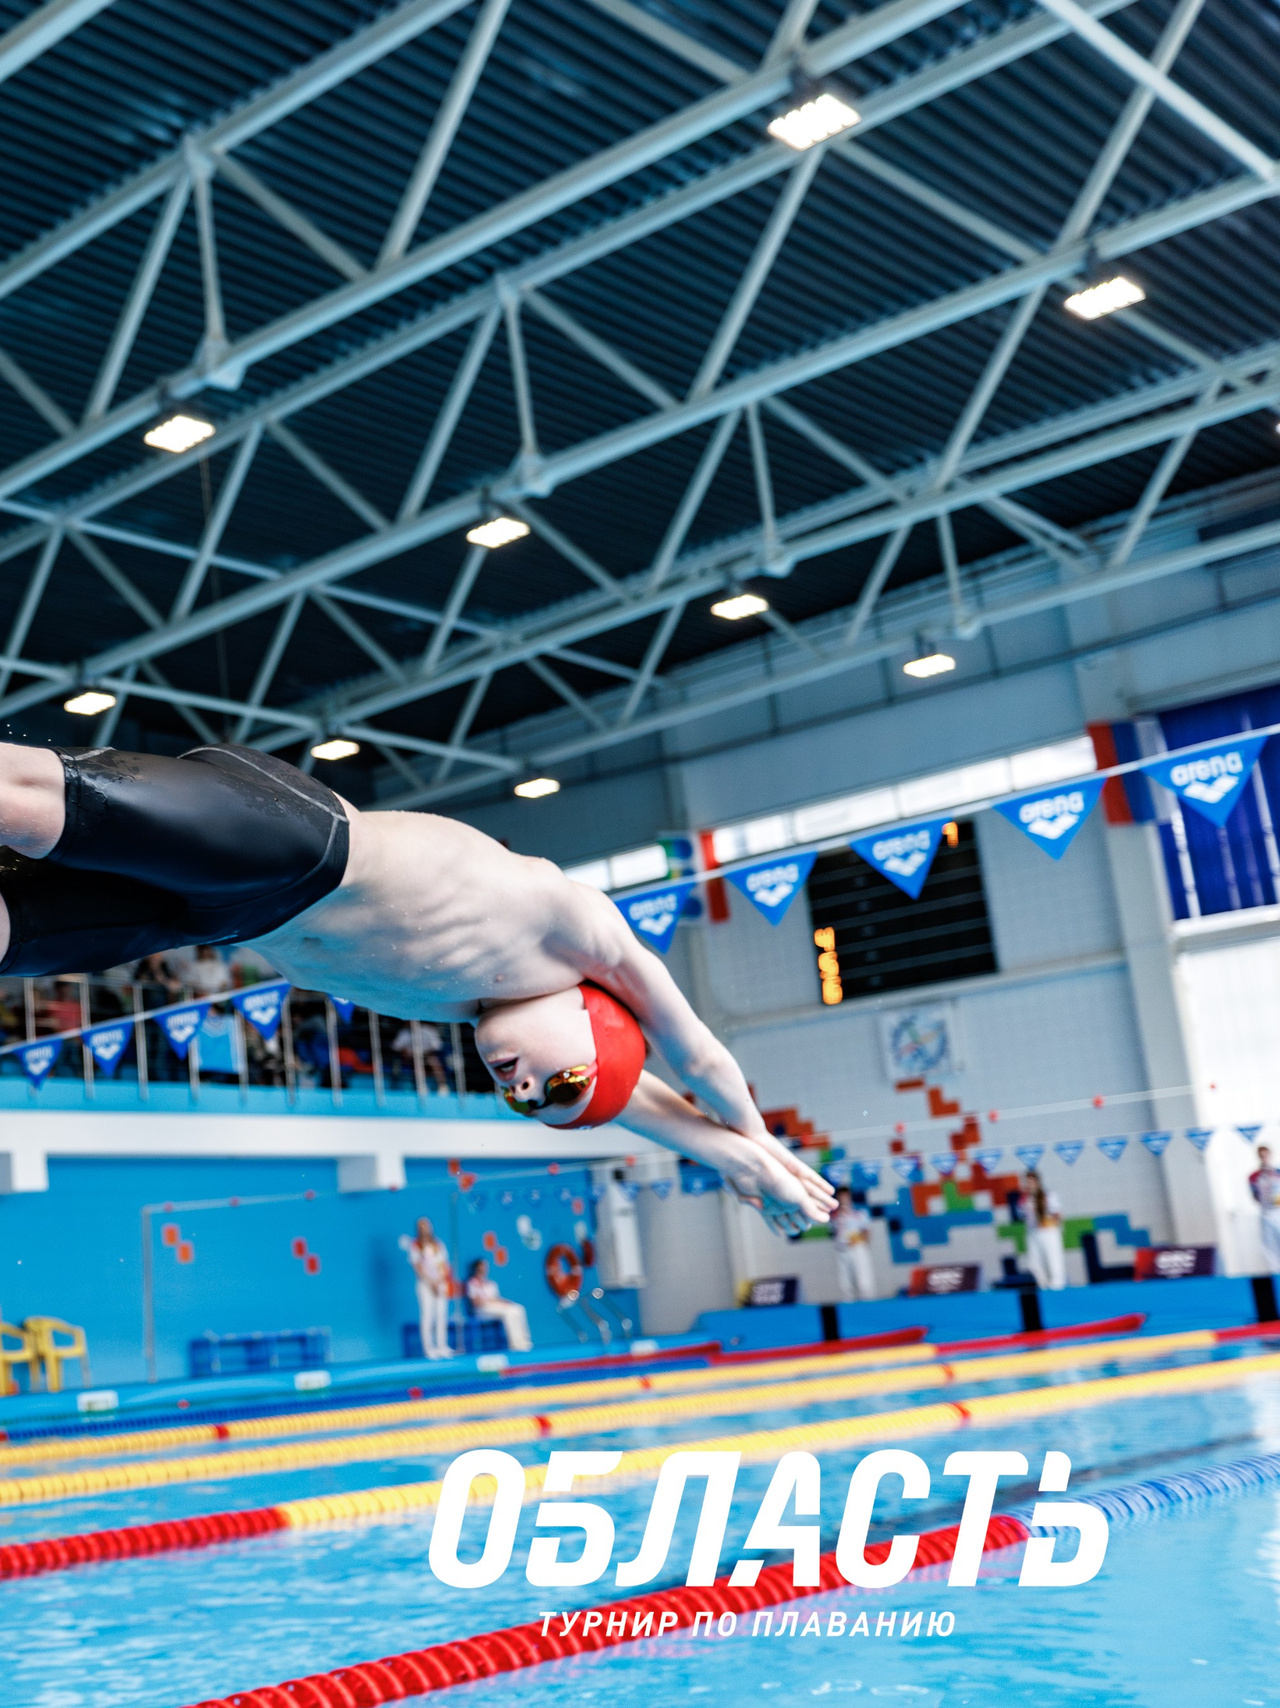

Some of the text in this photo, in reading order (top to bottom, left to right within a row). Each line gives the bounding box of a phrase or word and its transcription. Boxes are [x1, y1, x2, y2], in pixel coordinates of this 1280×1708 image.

[1170, 751, 1243, 787] arena
[1019, 791, 1084, 823] arena
[872, 829, 931, 861] arena
[746, 863, 800, 892] arena
